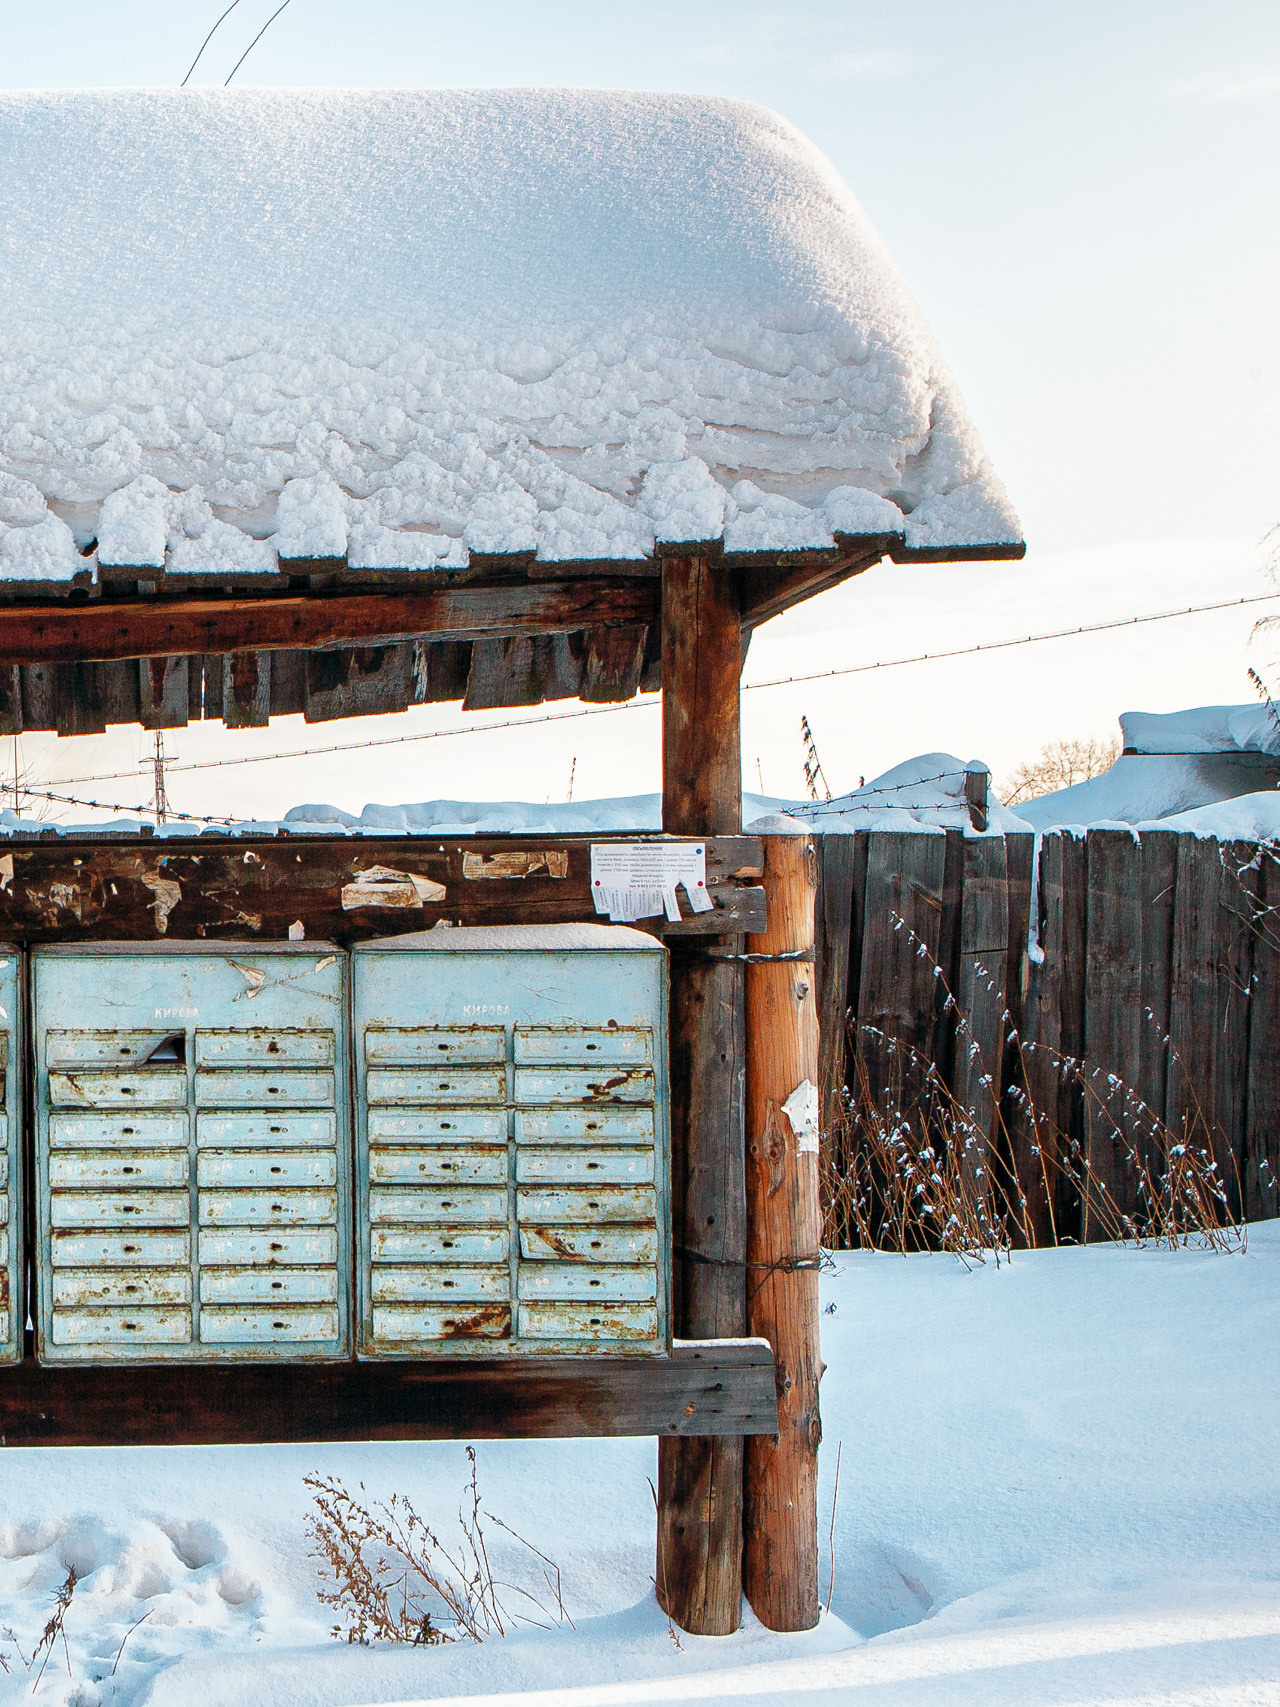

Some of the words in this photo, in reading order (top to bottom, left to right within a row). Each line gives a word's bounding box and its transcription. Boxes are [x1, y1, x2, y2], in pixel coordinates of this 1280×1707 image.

[154, 1007, 199, 1019] КИРОВА
[463, 1004, 510, 1017] КИРОВА
[628, 1161, 636, 1173] 2
